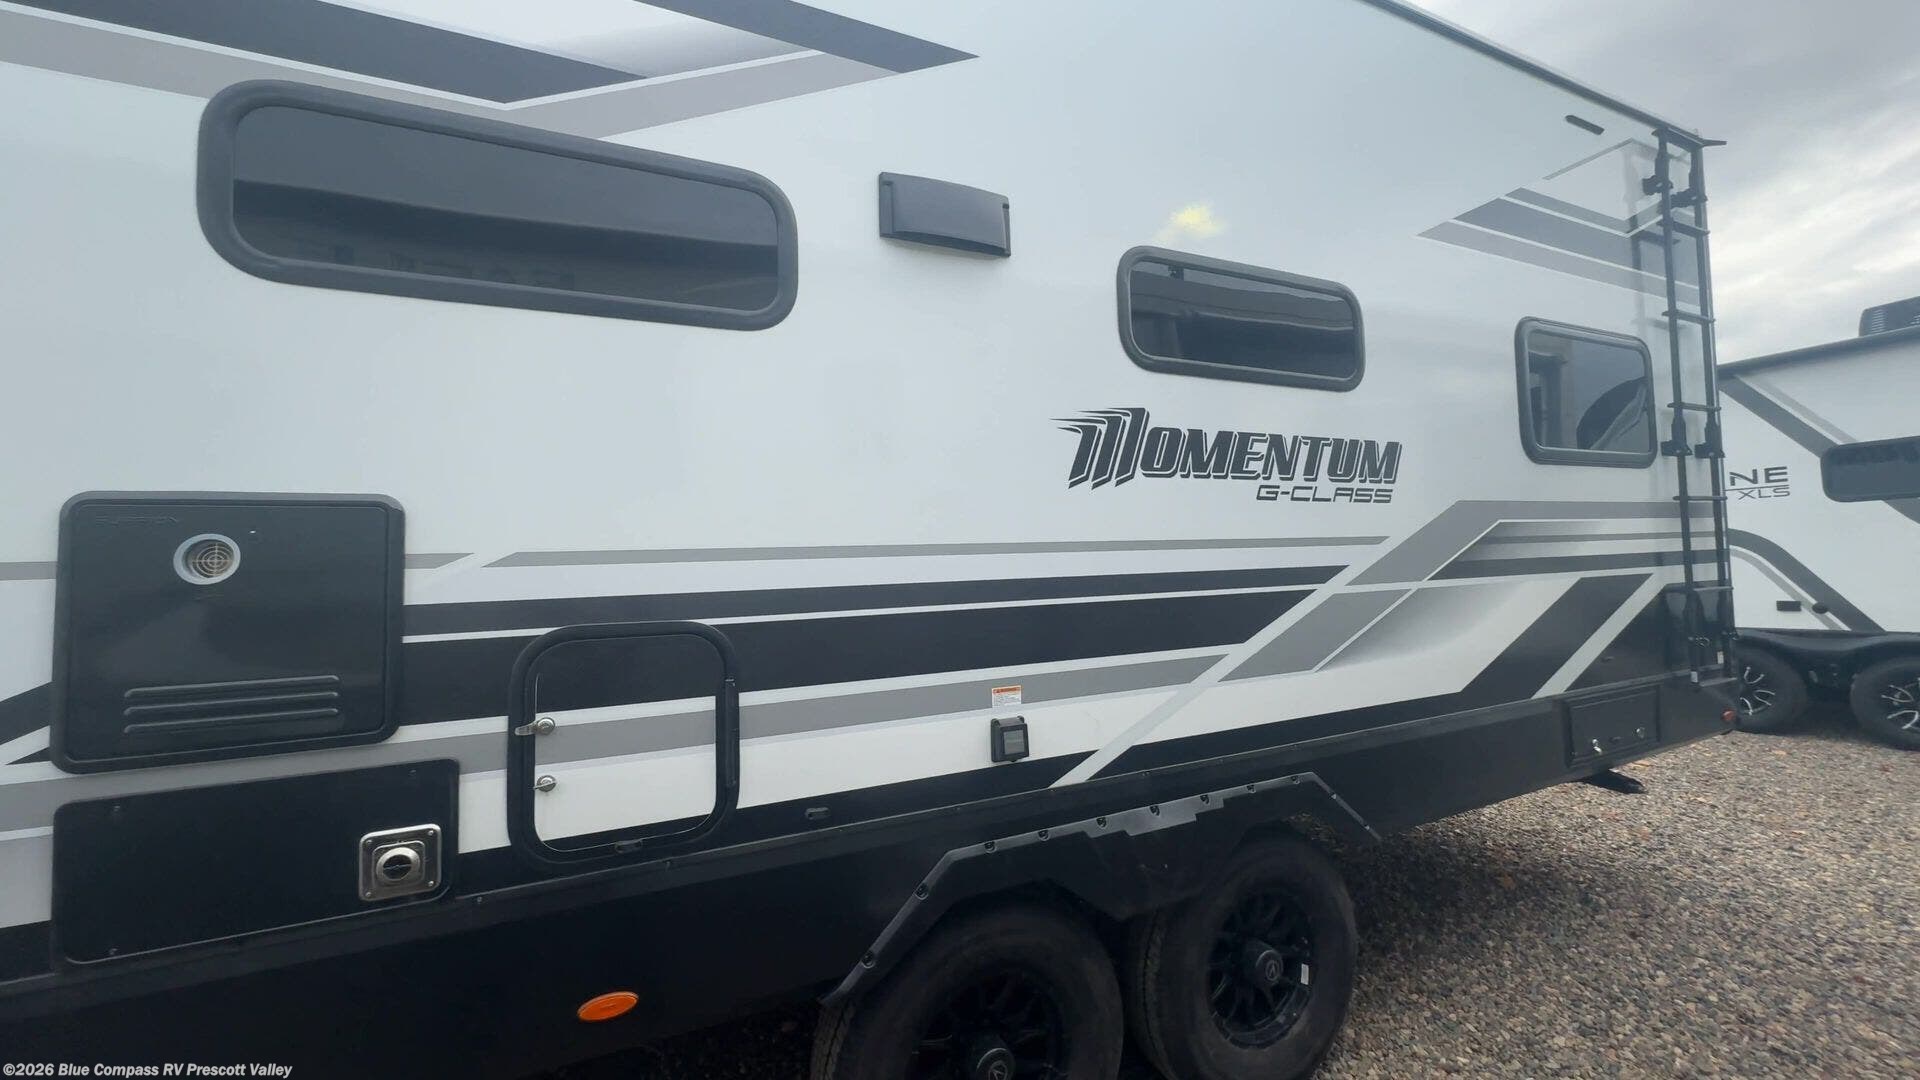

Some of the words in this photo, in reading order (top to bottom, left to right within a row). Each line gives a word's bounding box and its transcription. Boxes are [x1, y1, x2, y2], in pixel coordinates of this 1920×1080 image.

[1049, 407, 1402, 489] MOMENTUM
[1256, 485, 1393, 503] G-CLASS
[1738, 486, 1791, 500] XLS
